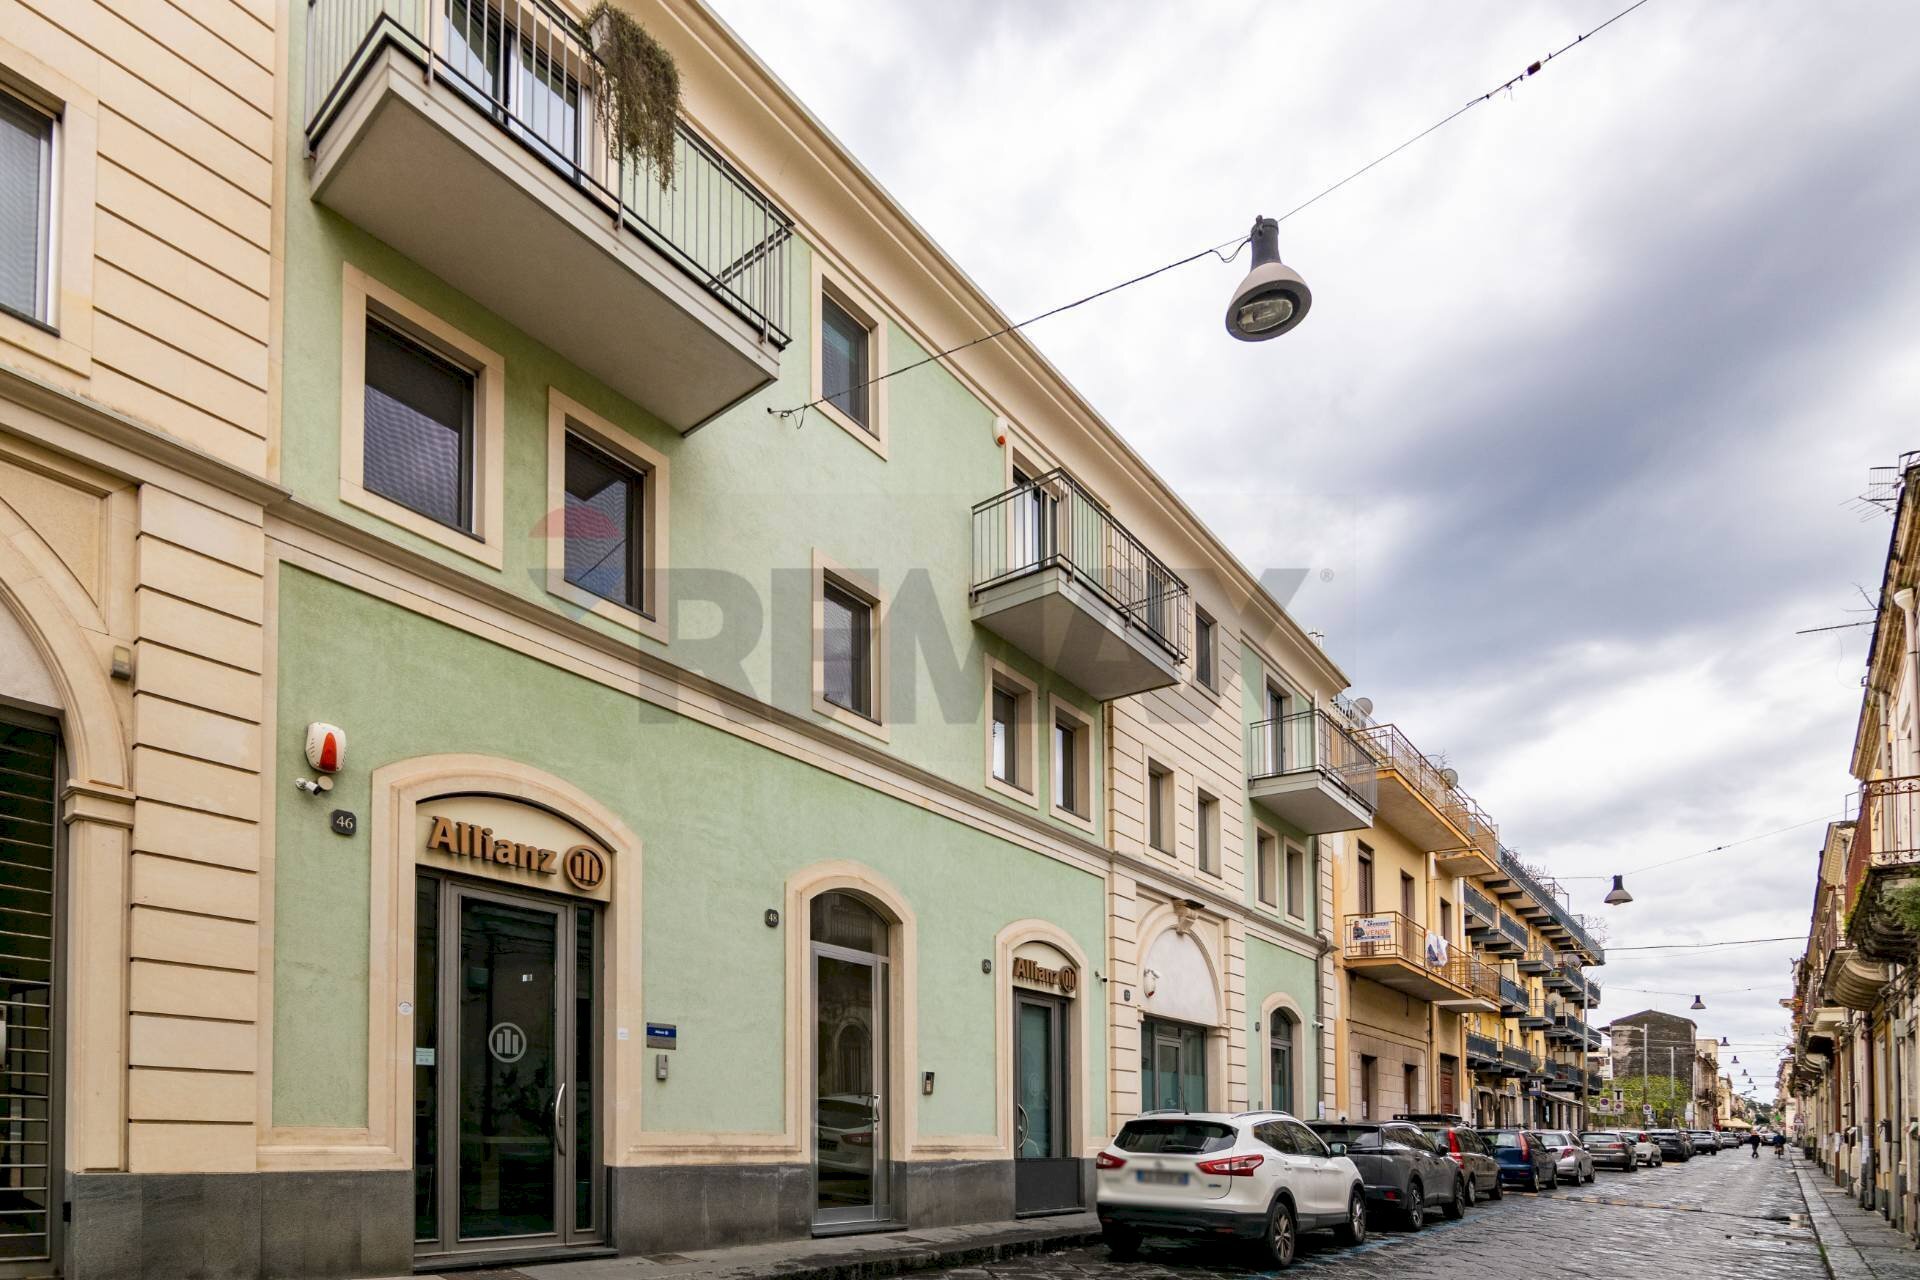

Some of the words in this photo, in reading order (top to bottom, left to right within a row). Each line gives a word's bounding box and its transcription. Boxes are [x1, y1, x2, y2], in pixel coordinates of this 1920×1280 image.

[336, 816, 353, 829] 46
[426, 816, 557, 874] Allianz
[768, 913, 778, 923] 48
[1012, 957, 1060, 985] Allianz
